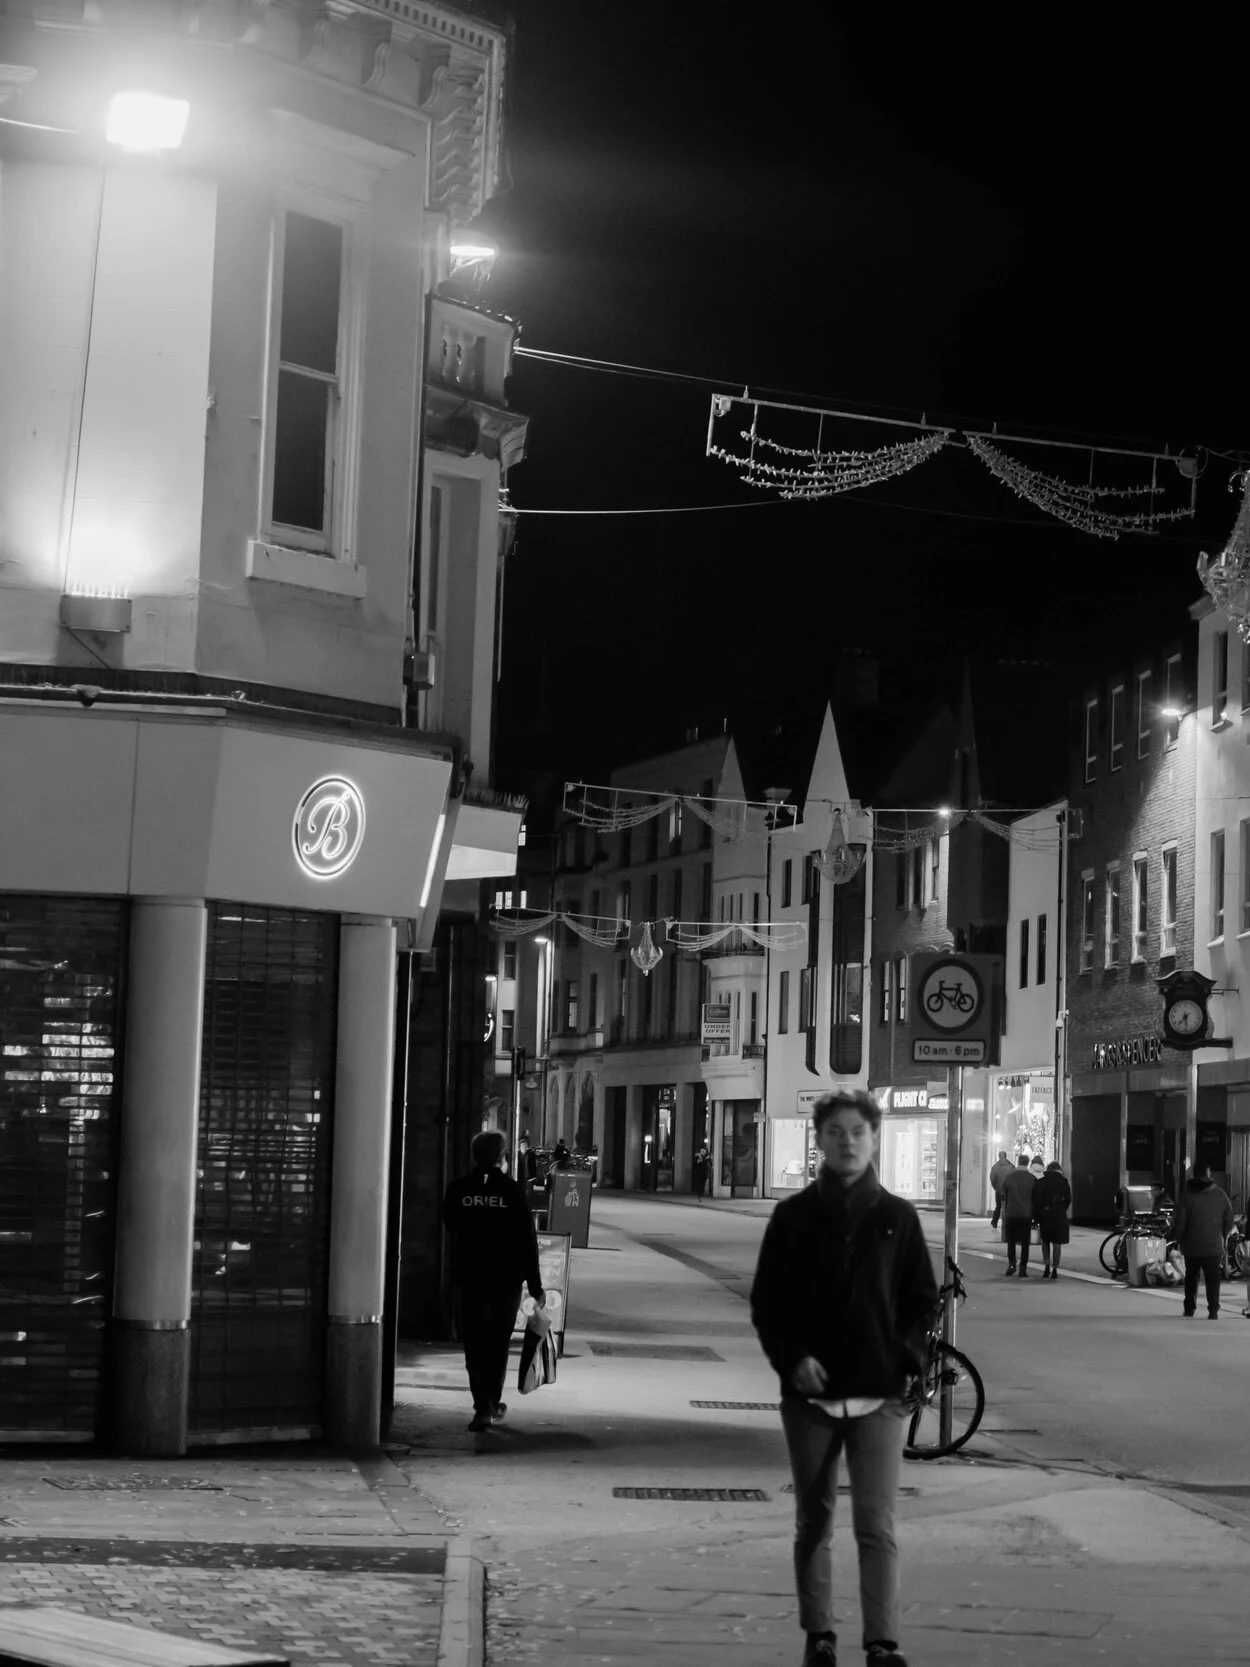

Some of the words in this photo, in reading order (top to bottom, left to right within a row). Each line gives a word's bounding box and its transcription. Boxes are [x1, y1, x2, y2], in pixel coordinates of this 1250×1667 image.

[918, 1045, 931, 1056] 10
[932, 1048, 948, 1056] am
[954, 1045, 962, 1056] 6
[963, 1048, 981, 1058] pm
[462, 1195, 508, 1208] ORIEL
